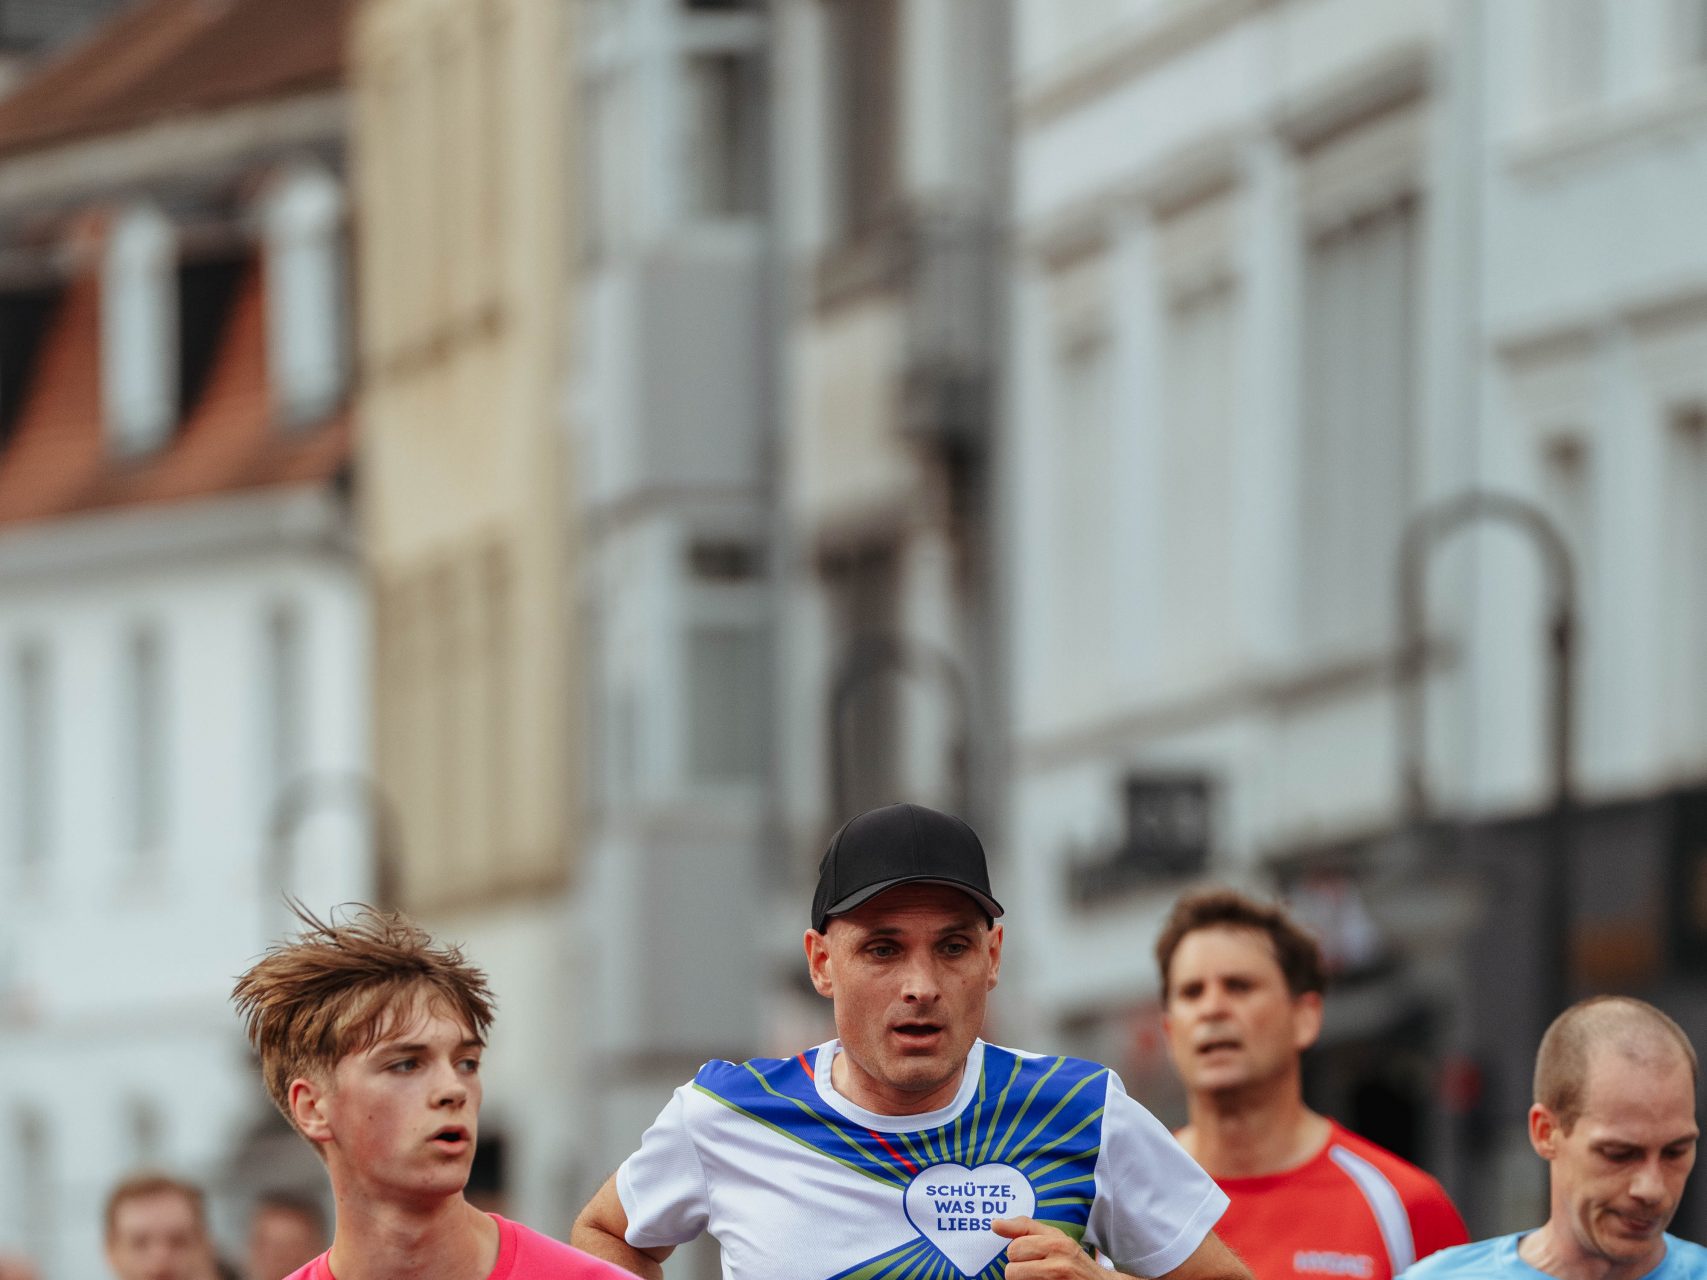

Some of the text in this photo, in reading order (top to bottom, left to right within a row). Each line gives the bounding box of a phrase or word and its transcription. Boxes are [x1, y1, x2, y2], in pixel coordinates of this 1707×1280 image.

[926, 1182, 1016, 1200] SCHÜTZE,
[934, 1200, 1007, 1214] WAS DU
[937, 1218, 992, 1231] LIEBS
